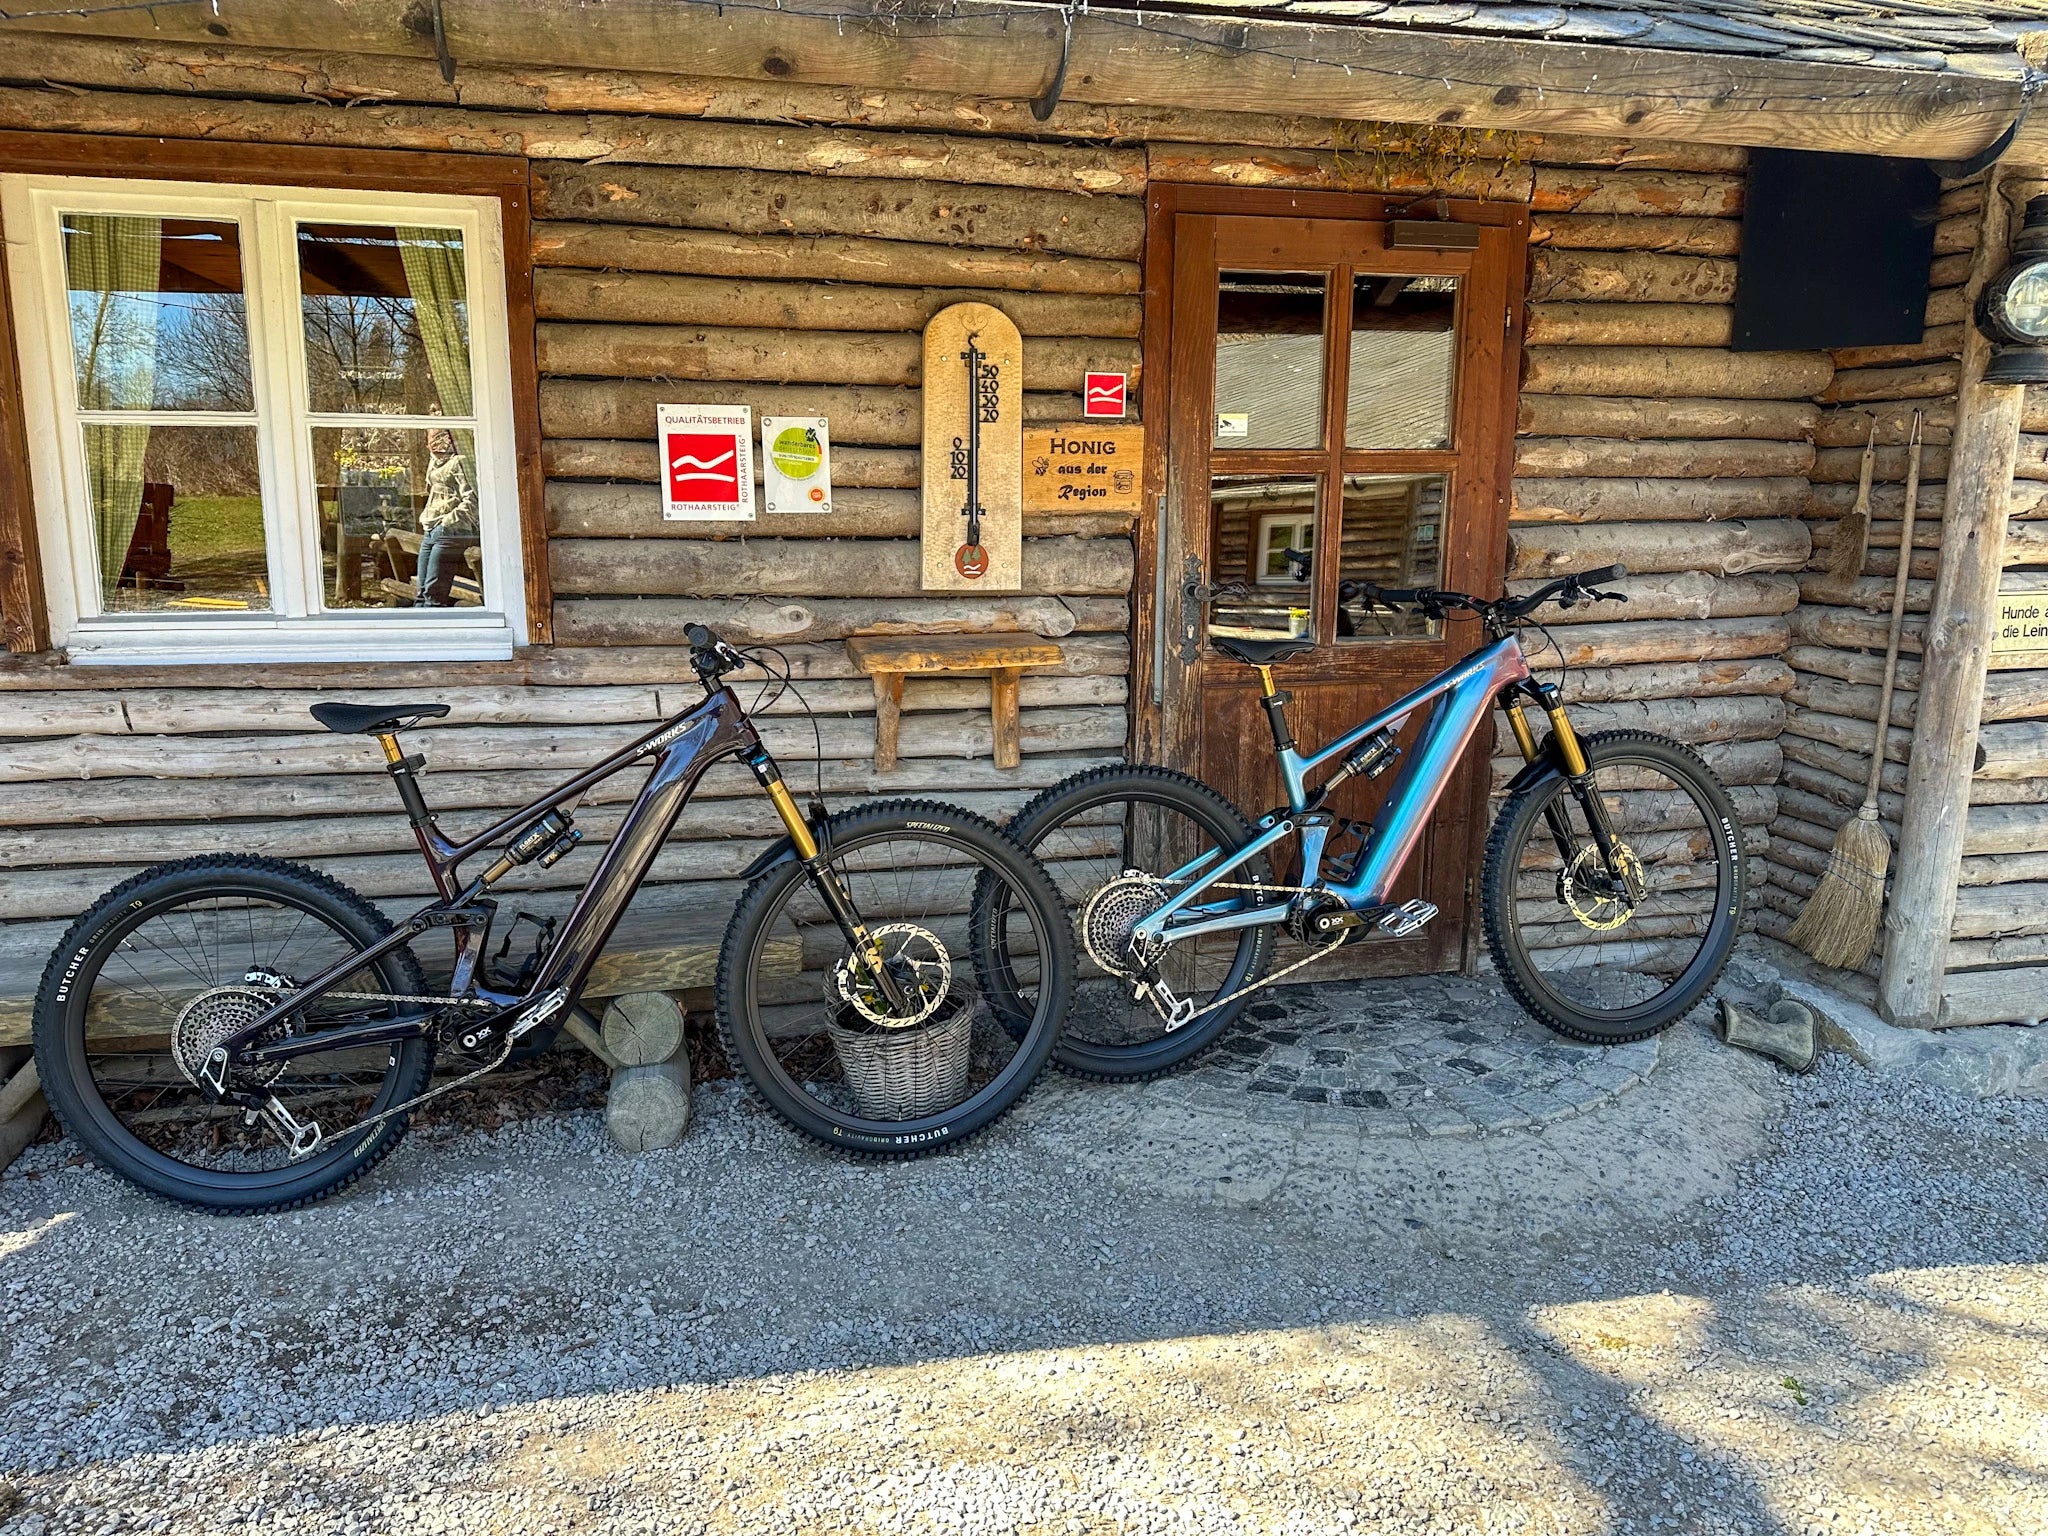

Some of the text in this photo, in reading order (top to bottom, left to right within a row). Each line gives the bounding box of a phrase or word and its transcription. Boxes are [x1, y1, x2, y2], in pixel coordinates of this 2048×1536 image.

[981, 365, 999, 379] 50
[981, 380, 999, 393] 40
[981, 395, 999, 408] 30
[665, 415, 746, 425] QUALITÄTSBETRIEB
[982, 409, 999, 422] 20
[1050, 438, 1116, 455] HONIG
[950, 451, 965, 465] 10
[951, 465, 966, 480] 20
[1058, 463, 1108, 475] aus der
[1058, 485, 1107, 501] Region
[2002, 606, 2039, 619] Hunde
[2002, 624, 2048, 637] die Lein
[636, 721, 687, 757] S-WORKS
[906, 821, 951, 833] SPECIALIZED
[1721, 817, 1738, 861] BUTCHER
[56, 946, 89, 1002] BUTCHER
[129, 899, 143, 910] T9
[895, 1126, 949, 1144] BUTCHER
